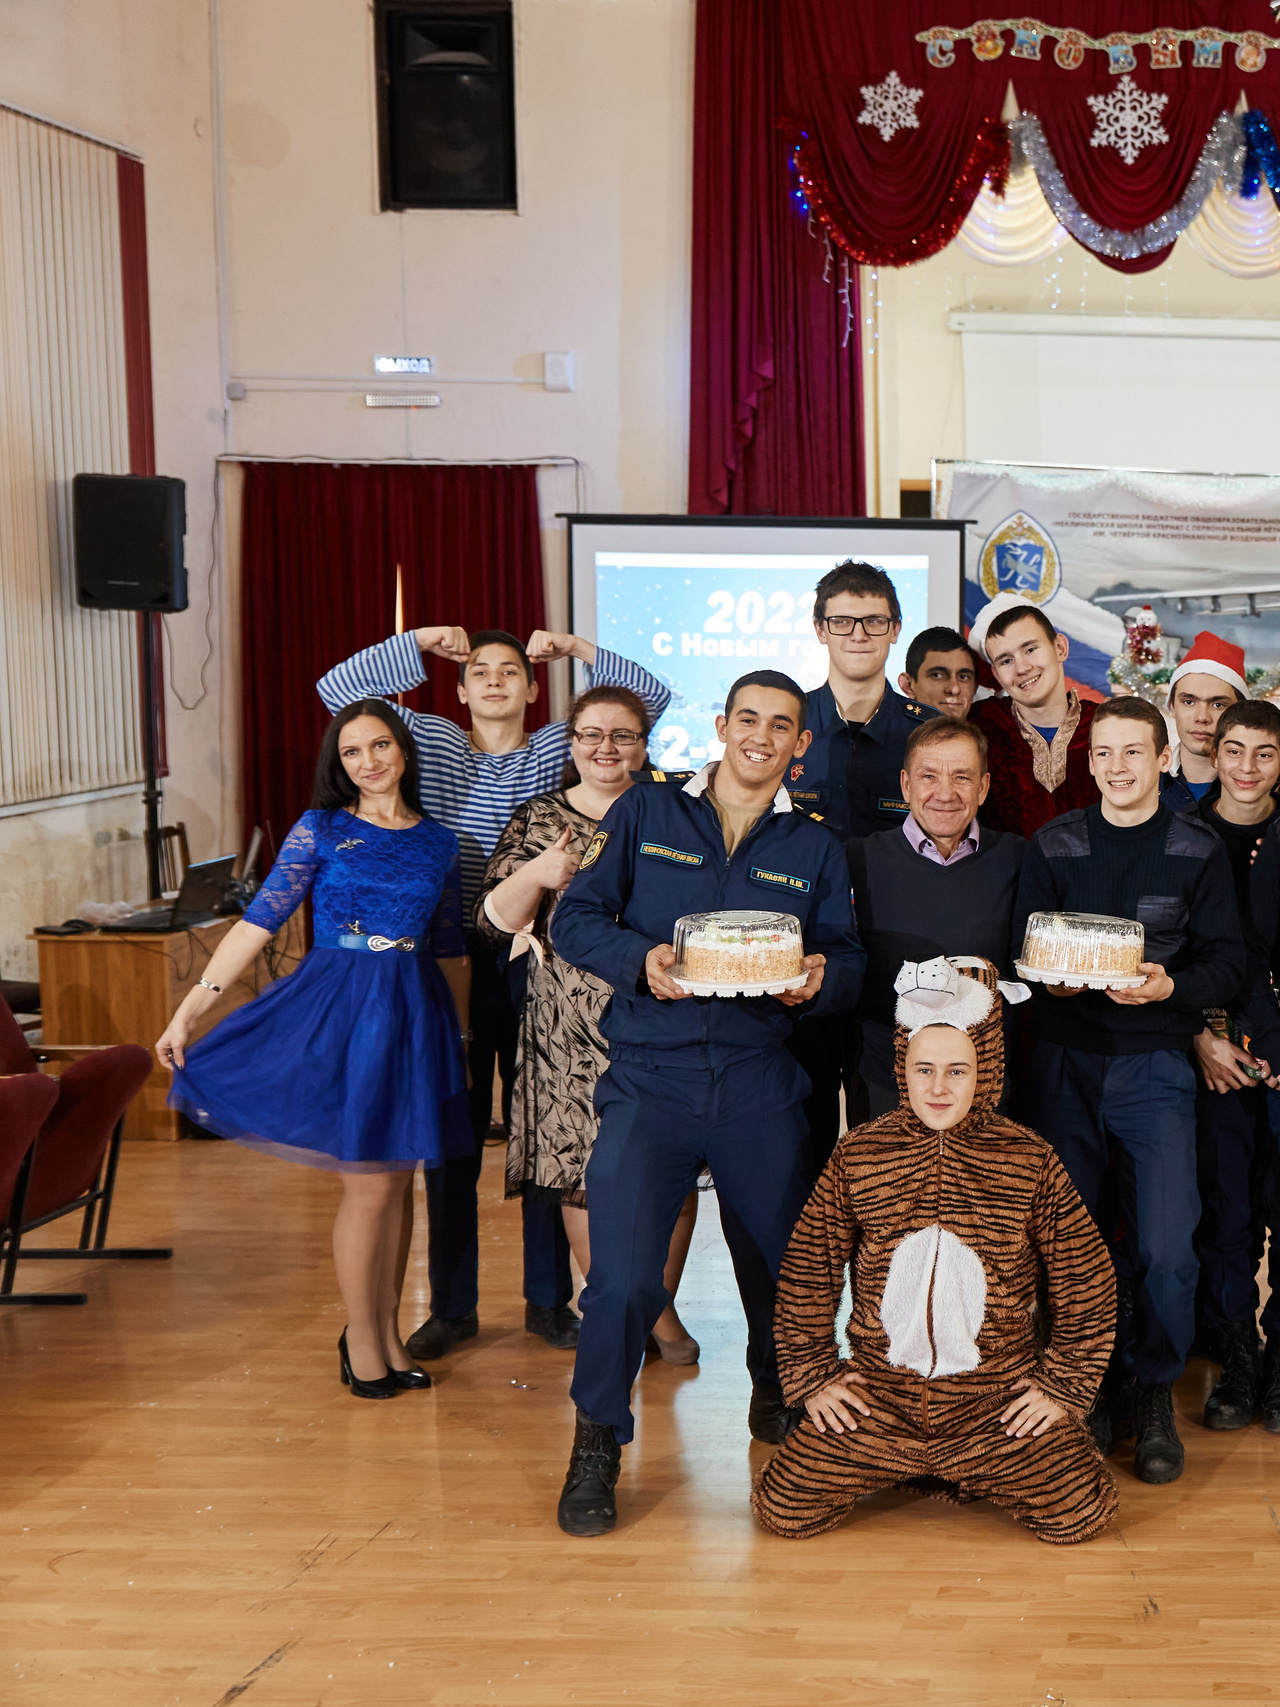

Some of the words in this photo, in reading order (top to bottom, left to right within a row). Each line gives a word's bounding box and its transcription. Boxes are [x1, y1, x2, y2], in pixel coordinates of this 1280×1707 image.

[1068, 512, 1139, 520] ГОСУДАРСТВЕННОЕ
[1142, 513, 1188, 522] БЮДЖЕТНОЕ
[652, 631, 674, 657] С
[681, 632, 779, 658] Новым
[882, 801, 910, 810] МИНАКО
